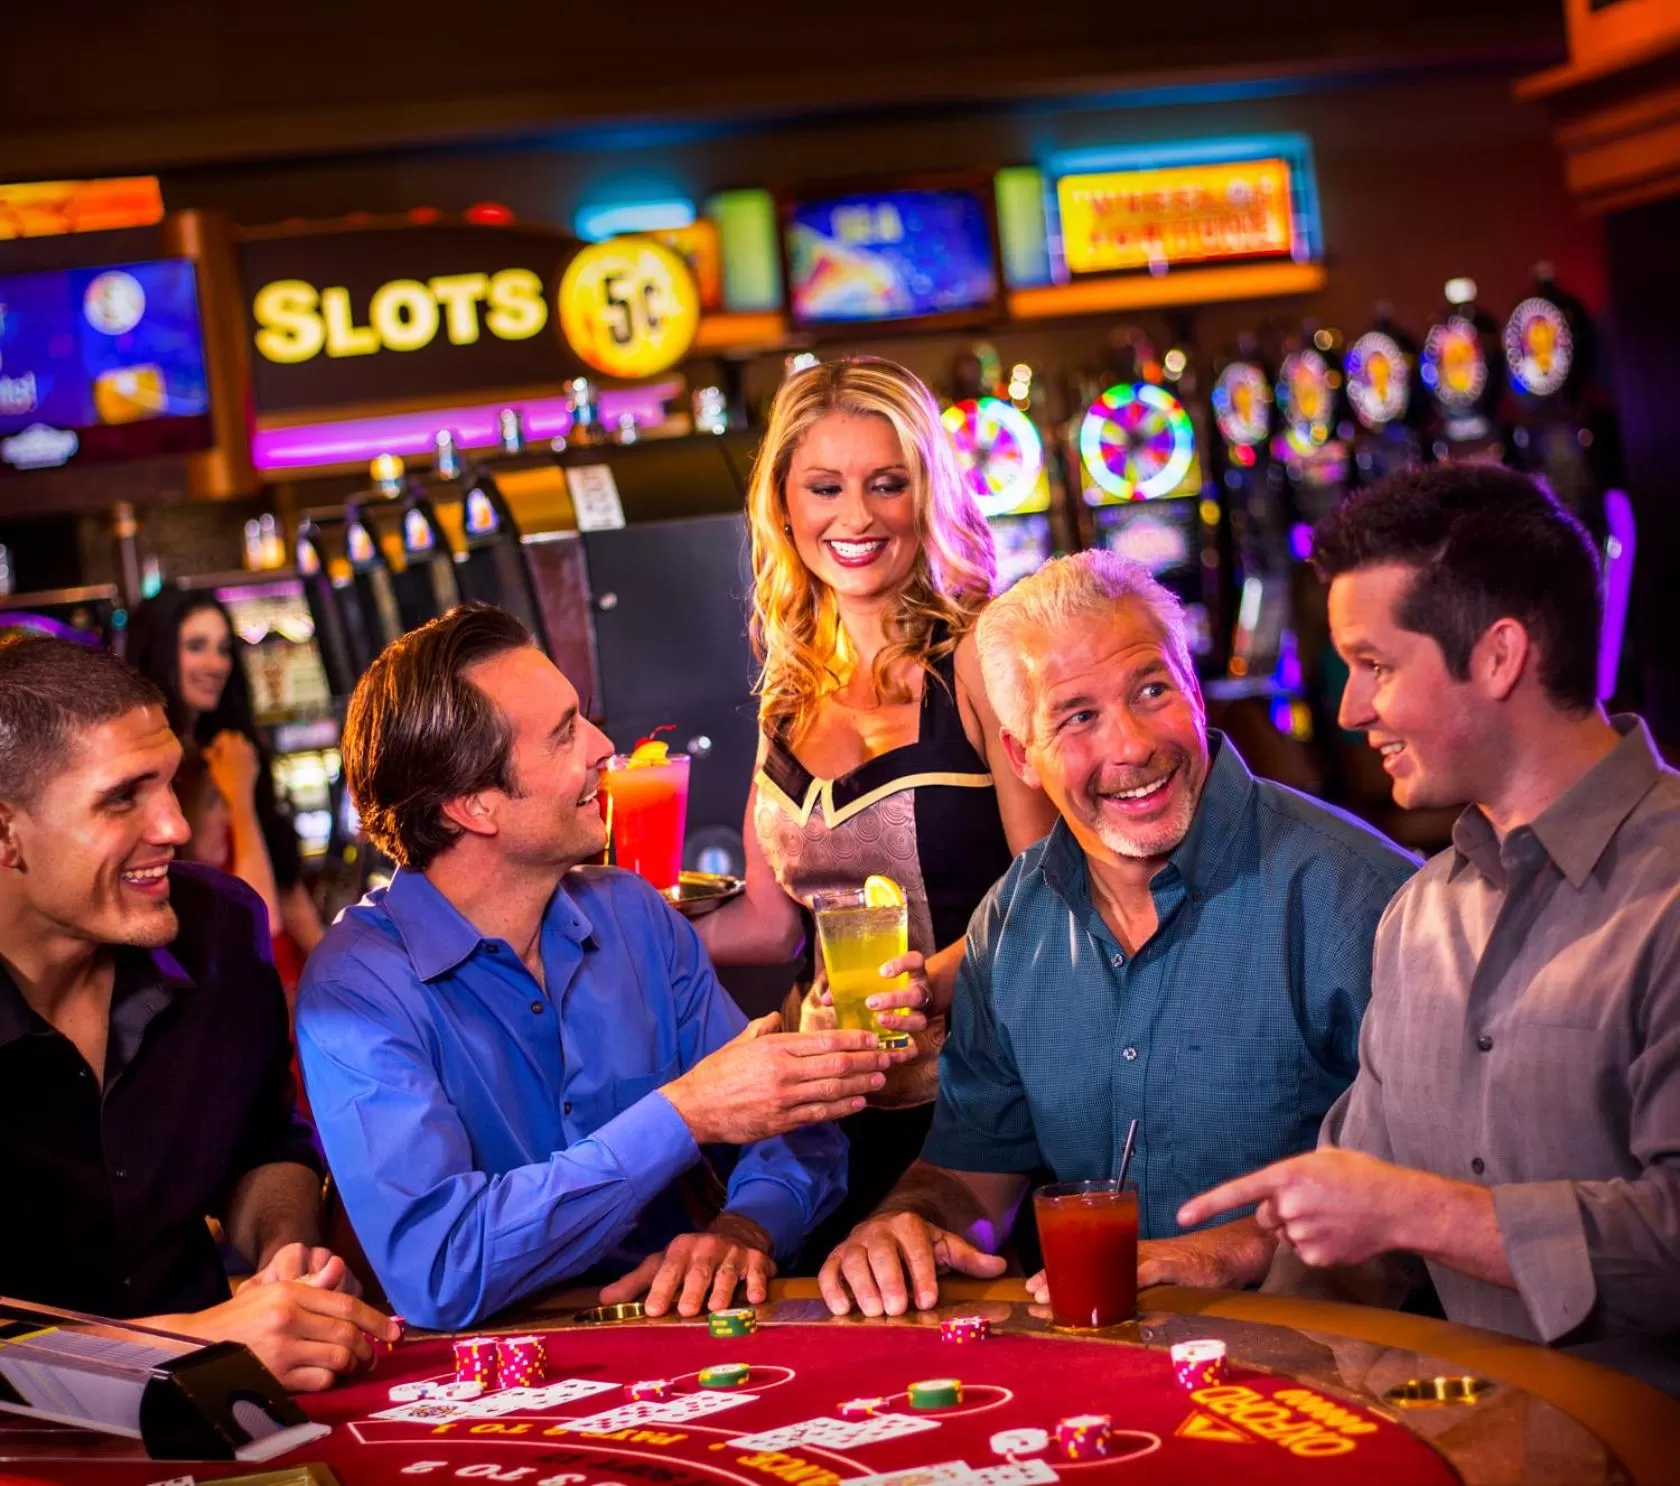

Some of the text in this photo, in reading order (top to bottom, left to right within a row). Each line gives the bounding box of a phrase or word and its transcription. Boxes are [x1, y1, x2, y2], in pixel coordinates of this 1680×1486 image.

[253, 268, 548, 363] SLOTS
[468, 1423, 533, 1435] TO
[400, 1460, 448, 1474] 2
[454, 1463, 537, 1482] TO
